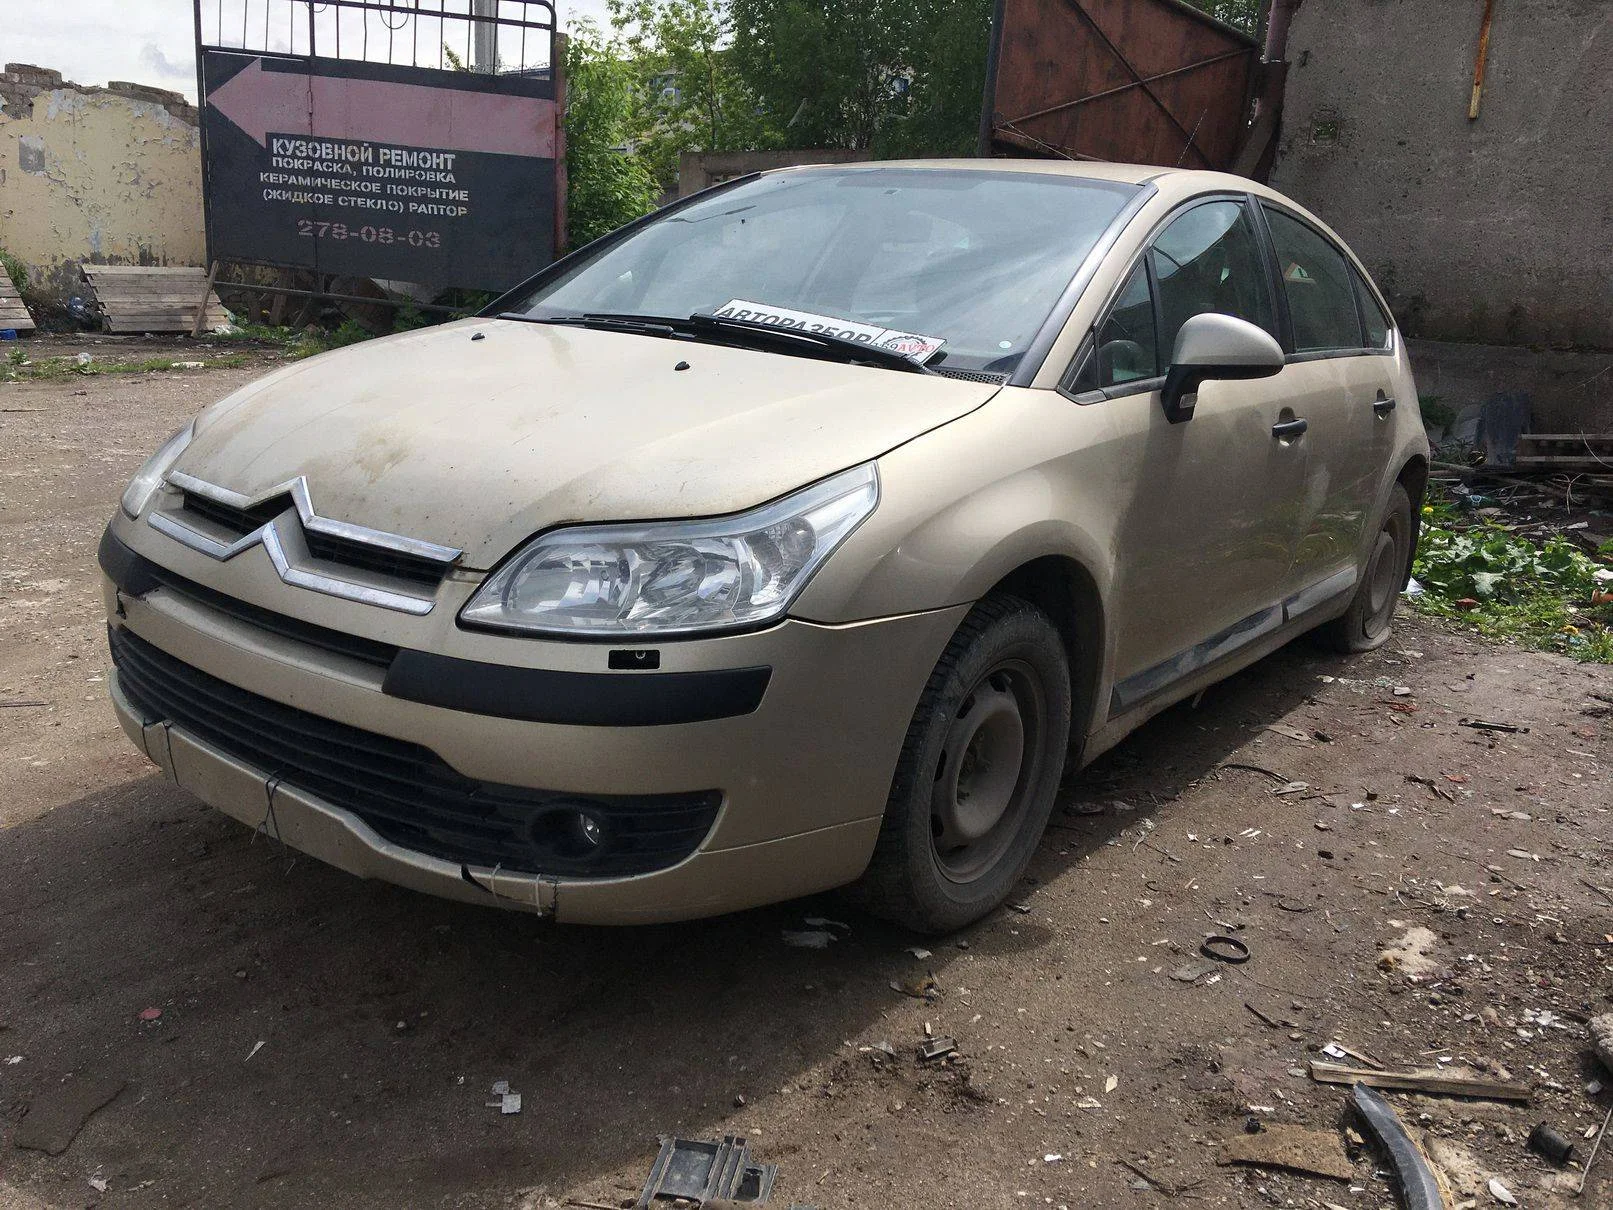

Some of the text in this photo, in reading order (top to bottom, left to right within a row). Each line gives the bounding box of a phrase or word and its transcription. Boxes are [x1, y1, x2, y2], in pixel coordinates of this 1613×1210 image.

[272, 138, 456, 170] КУЗОВНОЙ РЕМОНТ
[272, 157, 456, 183] ПОКРАСКА, ПОЛИРОВКА
[260, 172, 469, 201] КЕРАМИЧЕСКОЕ ПОКРЫТИЕ
[262, 188, 467, 217] (ЖИДКОЕ СТЕКЛО) РАПТОР
[297, 219, 441, 248] 278-08-03
